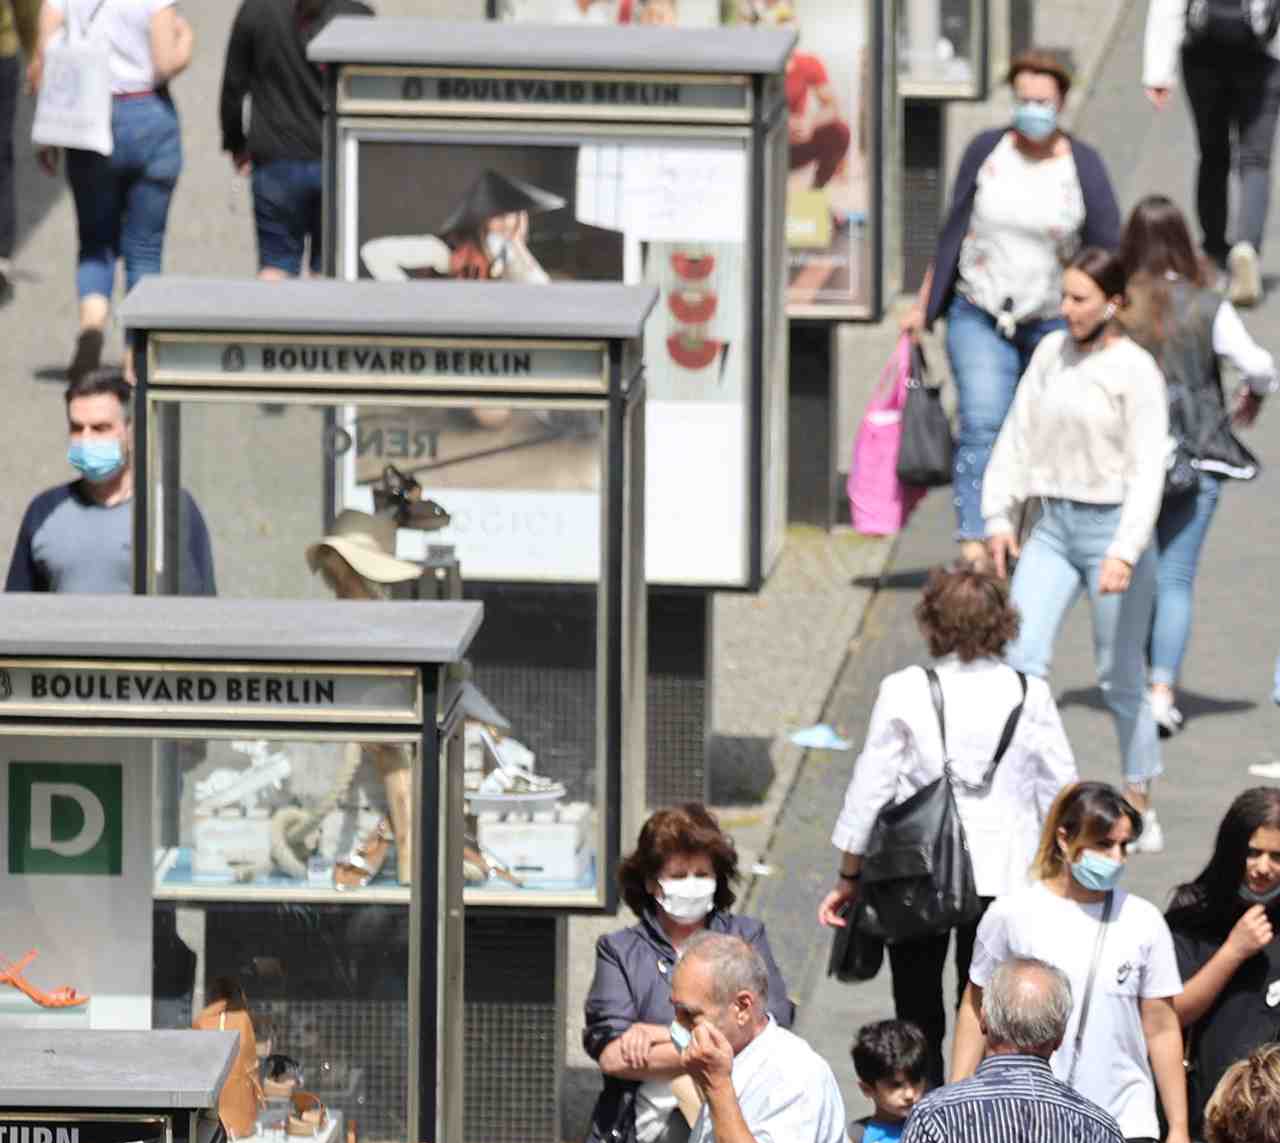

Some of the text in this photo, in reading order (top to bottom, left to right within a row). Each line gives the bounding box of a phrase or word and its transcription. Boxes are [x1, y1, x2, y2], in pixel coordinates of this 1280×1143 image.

[437, 80, 681, 105] BOULEVARD BERLIN
[261, 348, 531, 375] BOULEVARD BERLIN
[31, 674, 335, 704] BOULEVARD BERLIN
[30, 782, 105, 857] D
